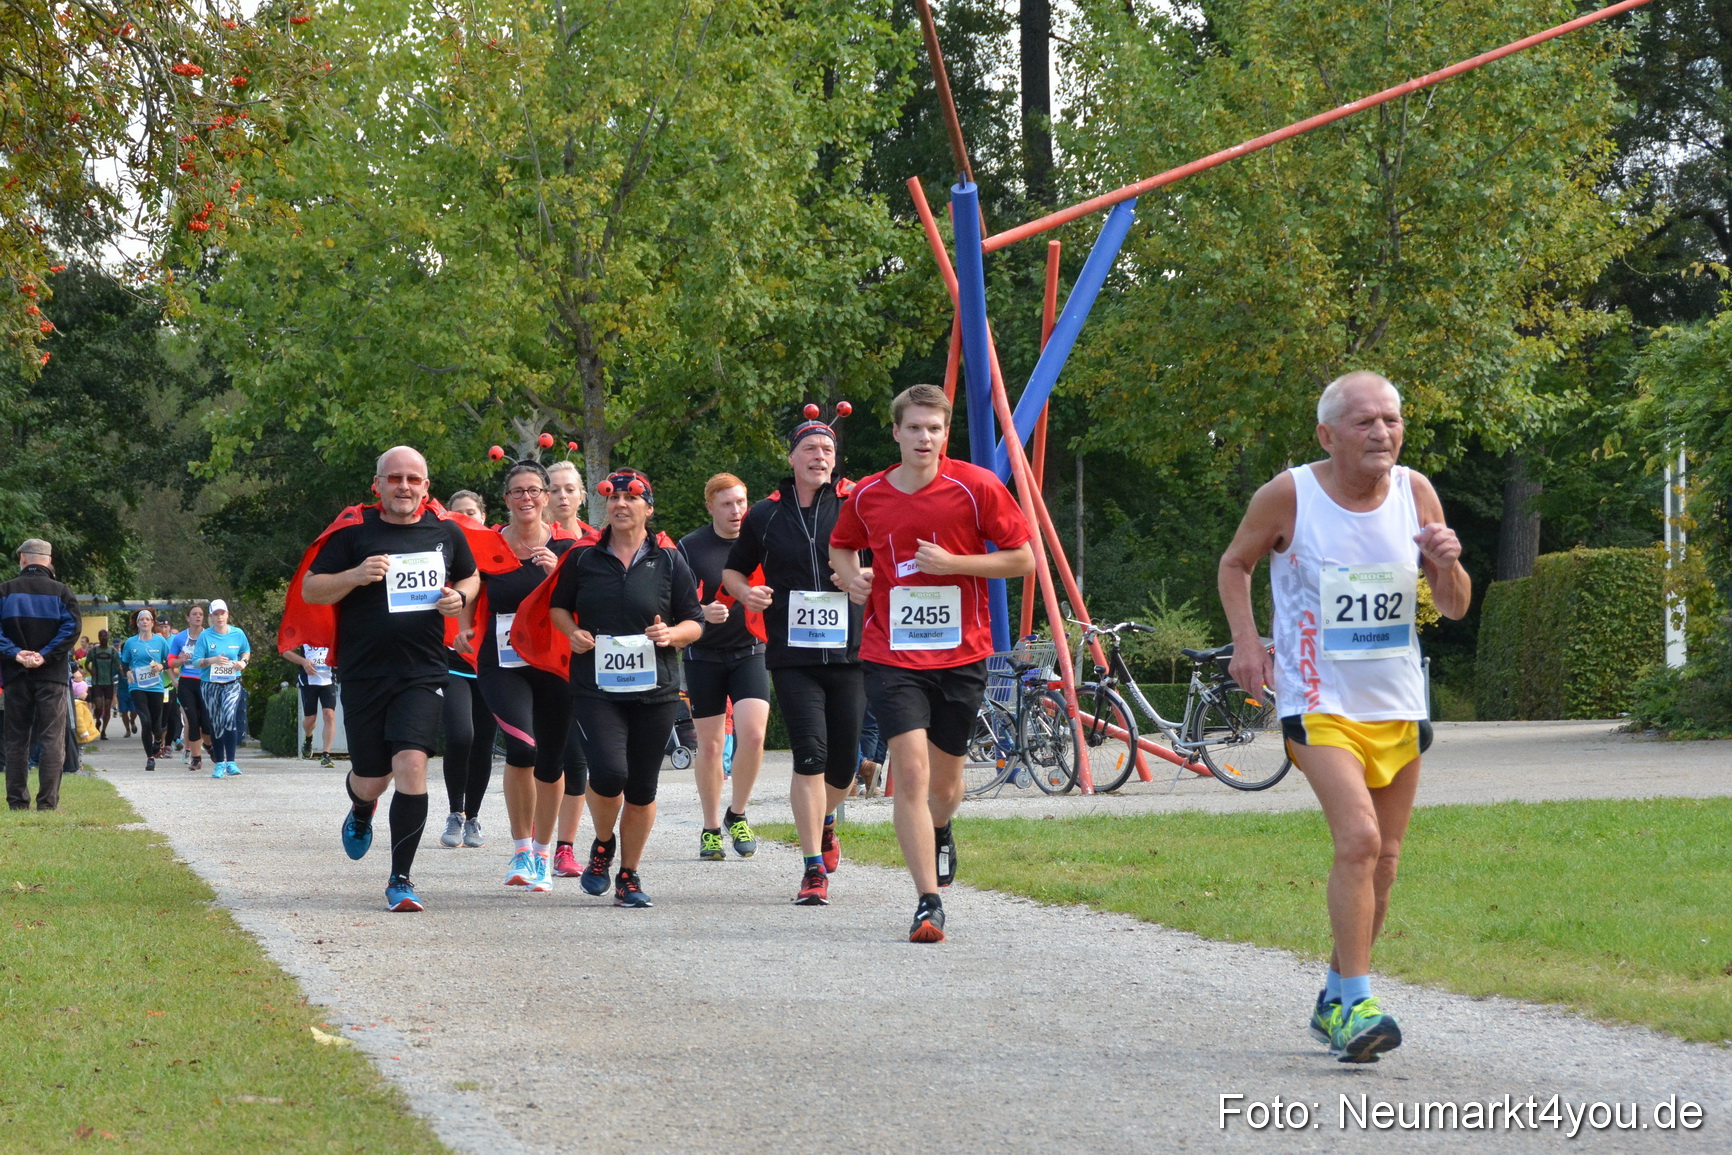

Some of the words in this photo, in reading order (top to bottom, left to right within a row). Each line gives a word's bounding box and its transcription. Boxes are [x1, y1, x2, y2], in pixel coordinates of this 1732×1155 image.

[396, 570, 438, 589] 2518
[1359, 572, 1394, 580] BOCK
[901, 606, 950, 625] 2455
[1336, 592, 1403, 622] 2182
[797, 608, 838, 626] 2139
[908, 631, 944, 639] Alexander
[1352, 632, 1390, 642] Andreas
[604, 652, 644, 670] 2041
